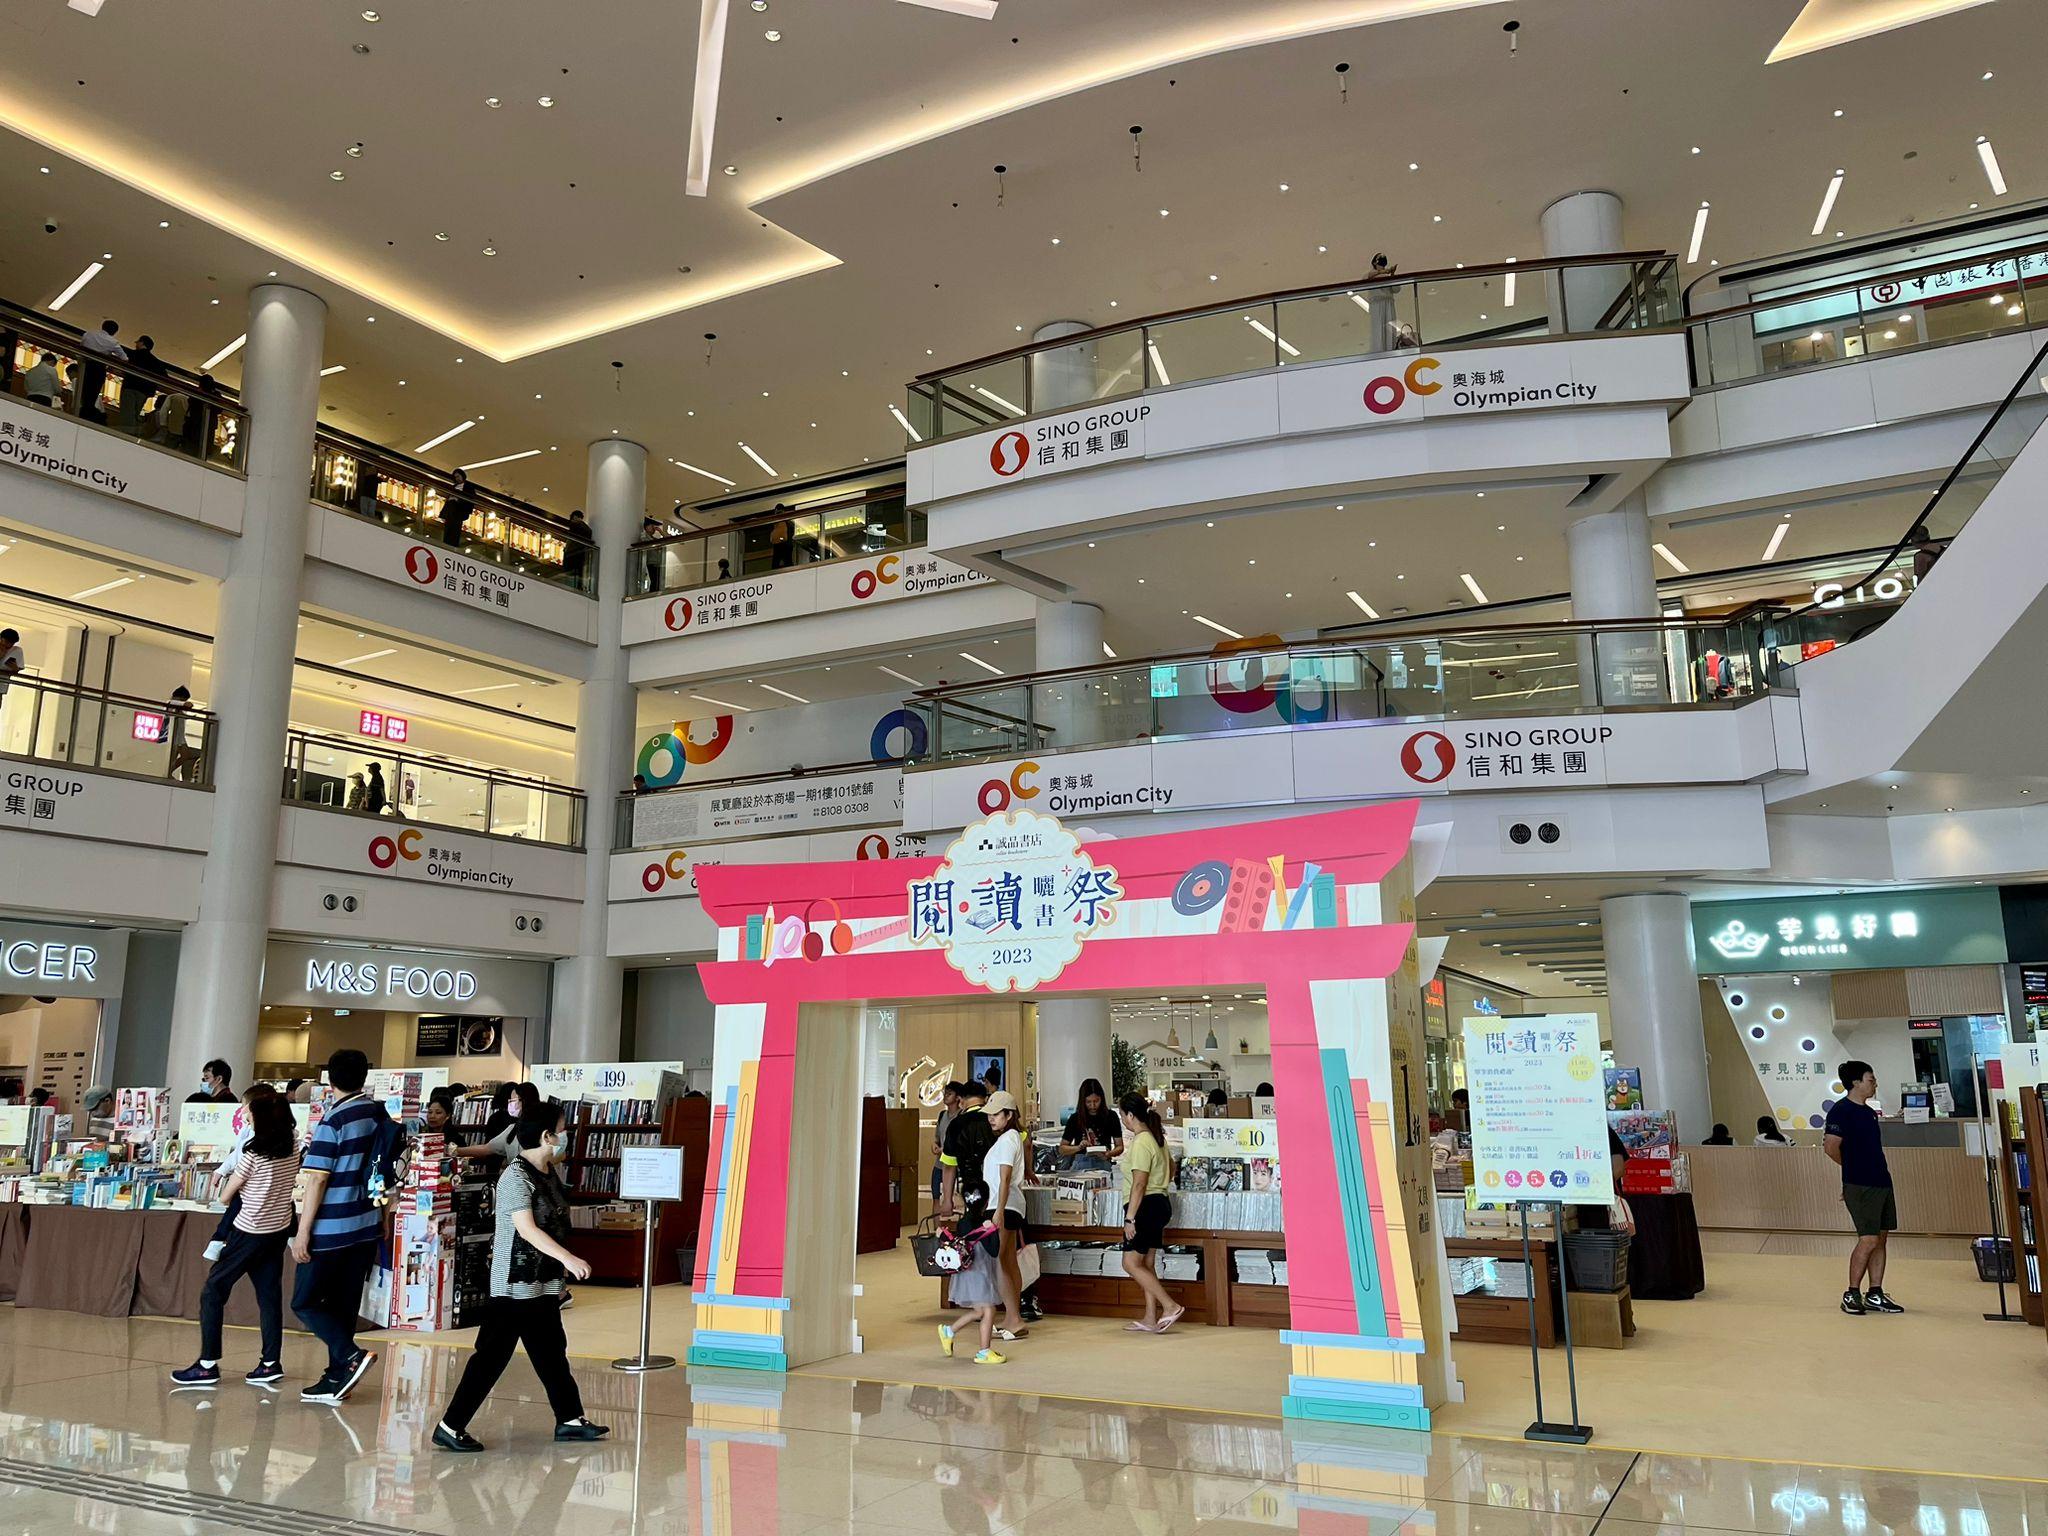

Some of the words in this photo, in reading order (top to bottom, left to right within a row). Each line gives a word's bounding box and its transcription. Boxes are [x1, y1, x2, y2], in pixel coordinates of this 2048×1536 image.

[1453, 387, 1552, 408] Olympian
[1555, 382, 1597, 401] City
[1037, 421, 1080, 442] SINO
[1085, 406, 1151, 432] GROUP
[1037, 430, 1128, 466] 信和集團
[0, 440, 88, 479] Olympian
[92, 469, 128, 493] City
[444, 557, 477, 577] SINO
[480, 569, 525, 592] GROUP
[905, 573, 965, 592] Olympian
[443, 573, 510, 608] 信和集團
[697, 591, 727, 607] SINO
[729, 583, 773, 602] GROUP
[697, 600, 758, 625] 信和集團
[1465, 730, 1521, 749] SINO
[1529, 727, 1613, 746] GROUP
[1467, 751, 1587, 778] 信和集團
[8, 772, 84, 797] GROUP
[821, 805, 843, 817] 8108
[844, 802, 869, 814] 0308
[1049, 791, 1133, 813] Olympian
[1136, 787, 1173, 804] City
[427, 863, 487, 884] Olympian
[489, 871, 514, 889] City
[992, 948, 1032, 965] 2023
[308, 959, 378, 994] M&S
[387, 965, 477, 1000] FOOD
[1524, 1059, 1543, 1067] 2023
[604, 1070, 626, 1087] 199
[1249, 1130, 1265, 1146] 10
[1069, 1180, 1084, 1189] OUT
